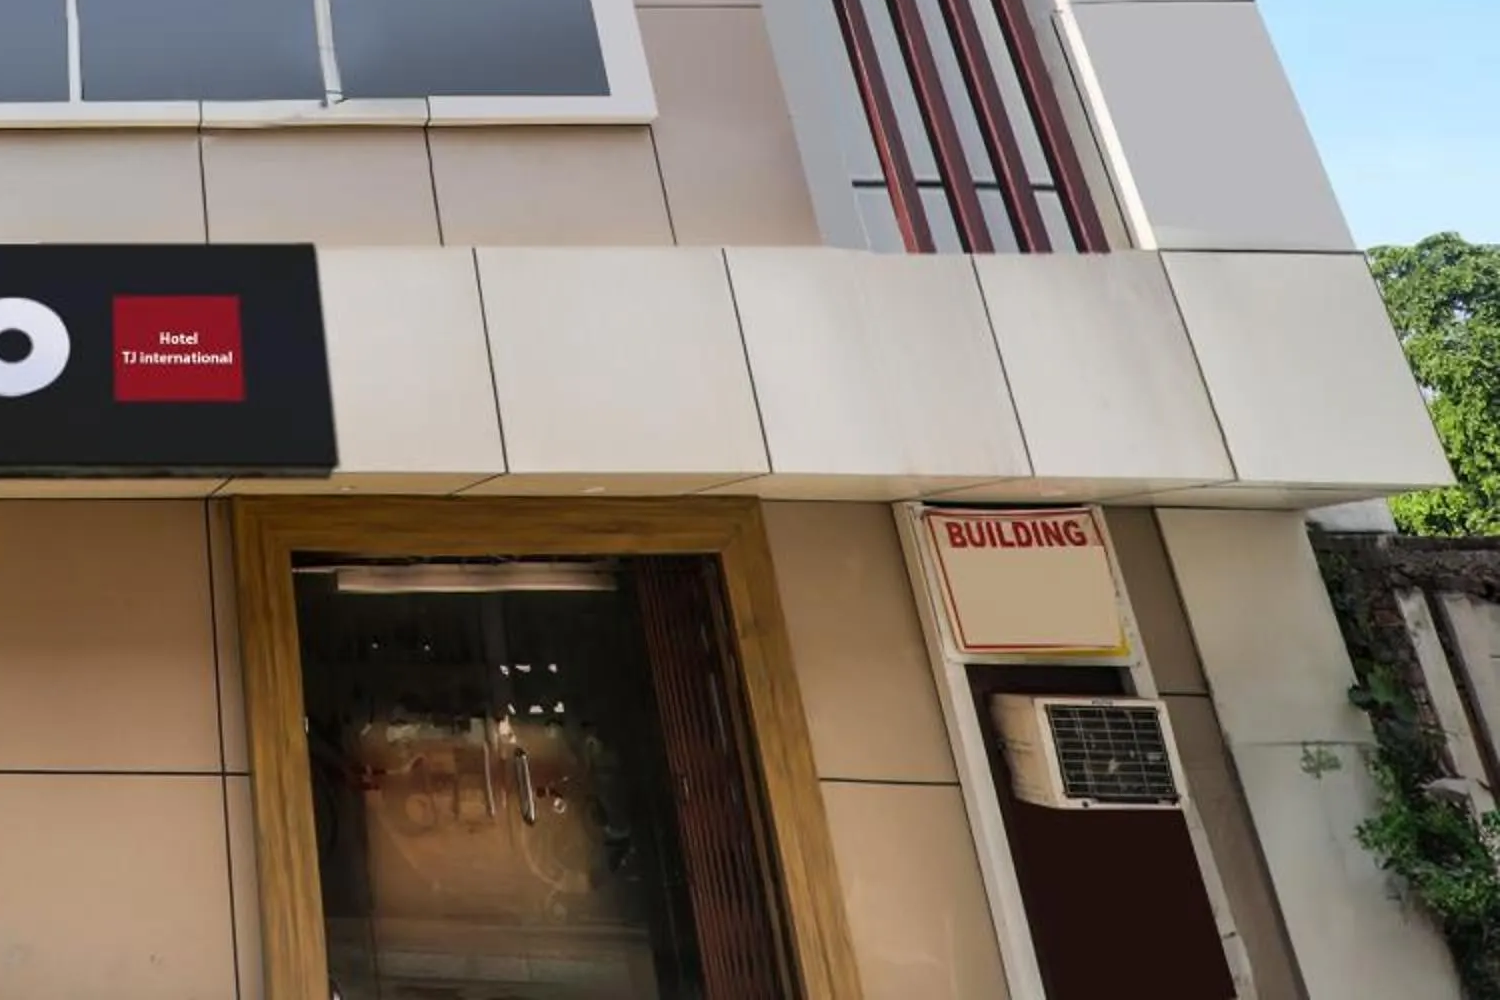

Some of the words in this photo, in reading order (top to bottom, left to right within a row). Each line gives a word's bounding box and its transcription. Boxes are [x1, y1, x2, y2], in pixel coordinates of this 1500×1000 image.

[158, 331, 199, 345] Hotel
[121, 351, 137, 365] TJ
[139, 351, 233, 365] international
[946, 520, 1087, 548] BUILDING
